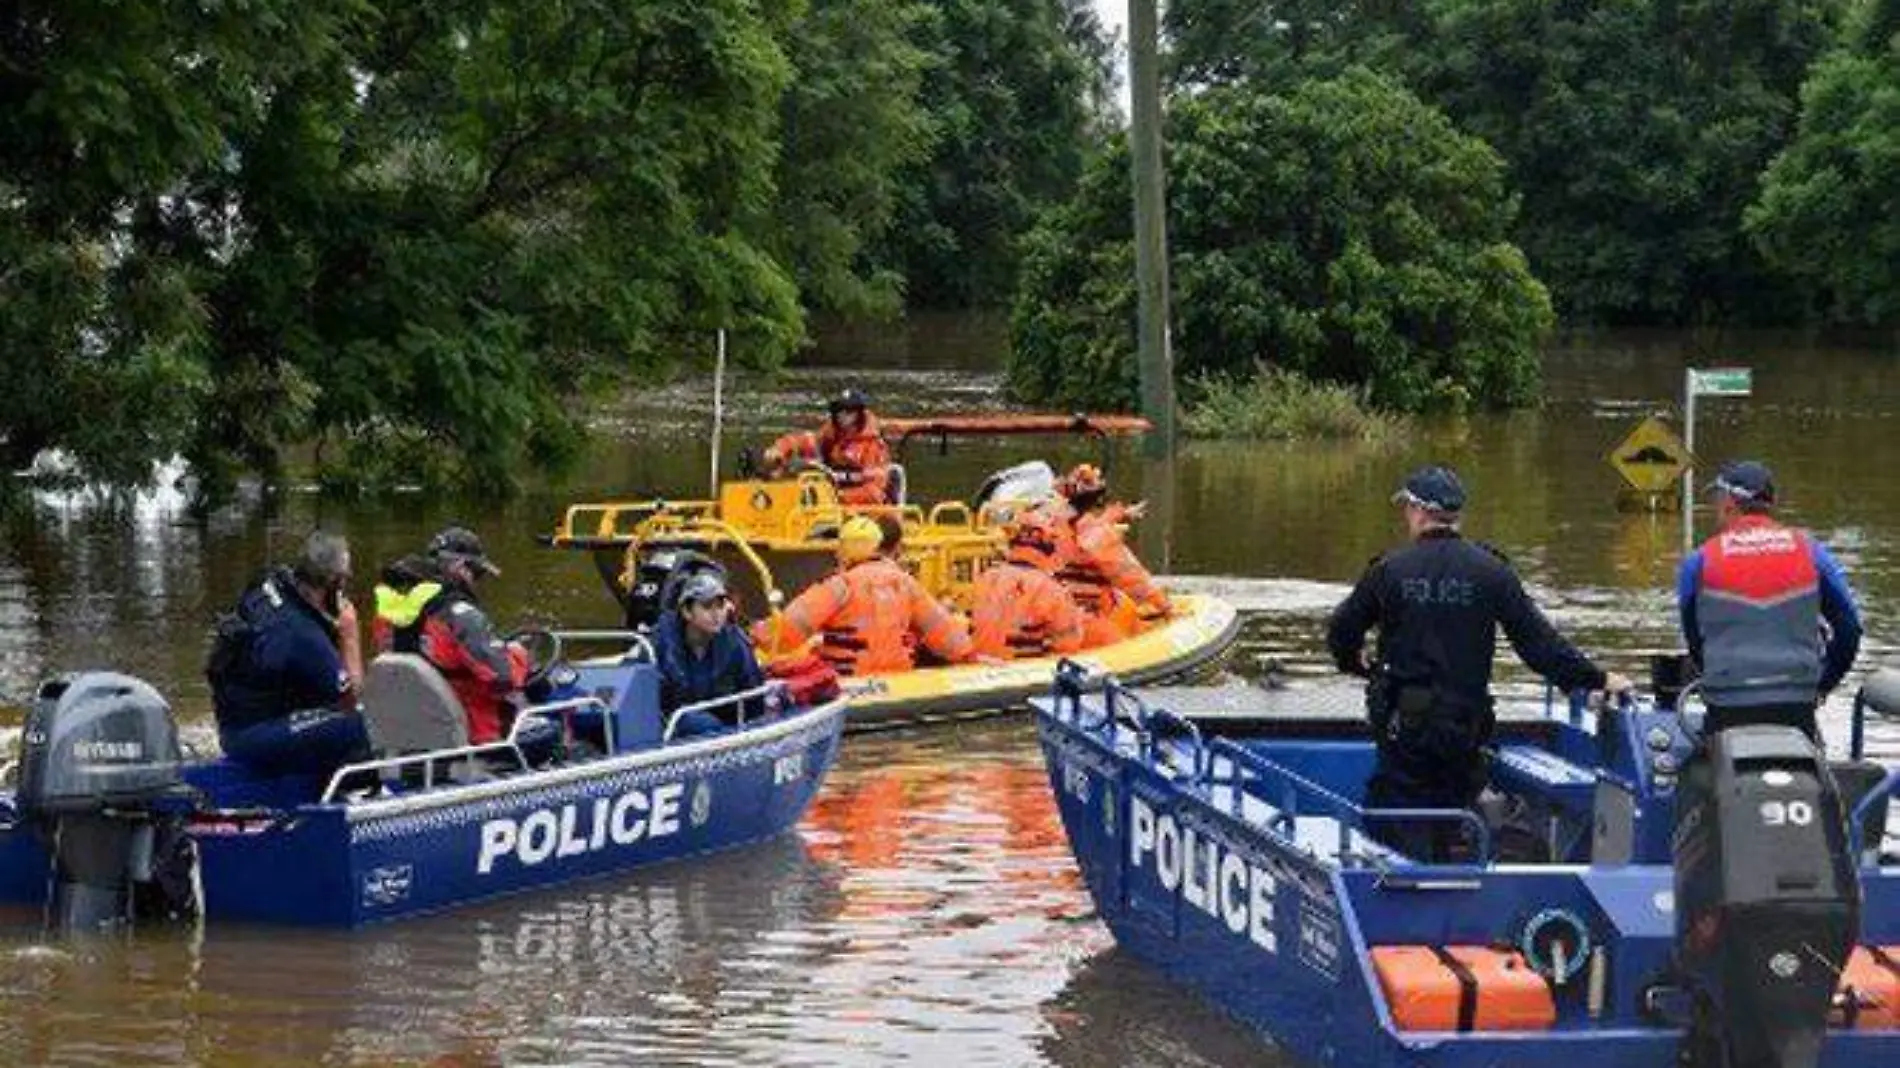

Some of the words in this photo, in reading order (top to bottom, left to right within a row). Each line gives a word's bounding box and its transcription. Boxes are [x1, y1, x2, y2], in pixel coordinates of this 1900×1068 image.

[1401, 577, 1475, 606] POLICE
[477, 783, 683, 873] POLICE
[1759, 801, 1813, 826] 90
[1130, 795, 1278, 955] POLICE
